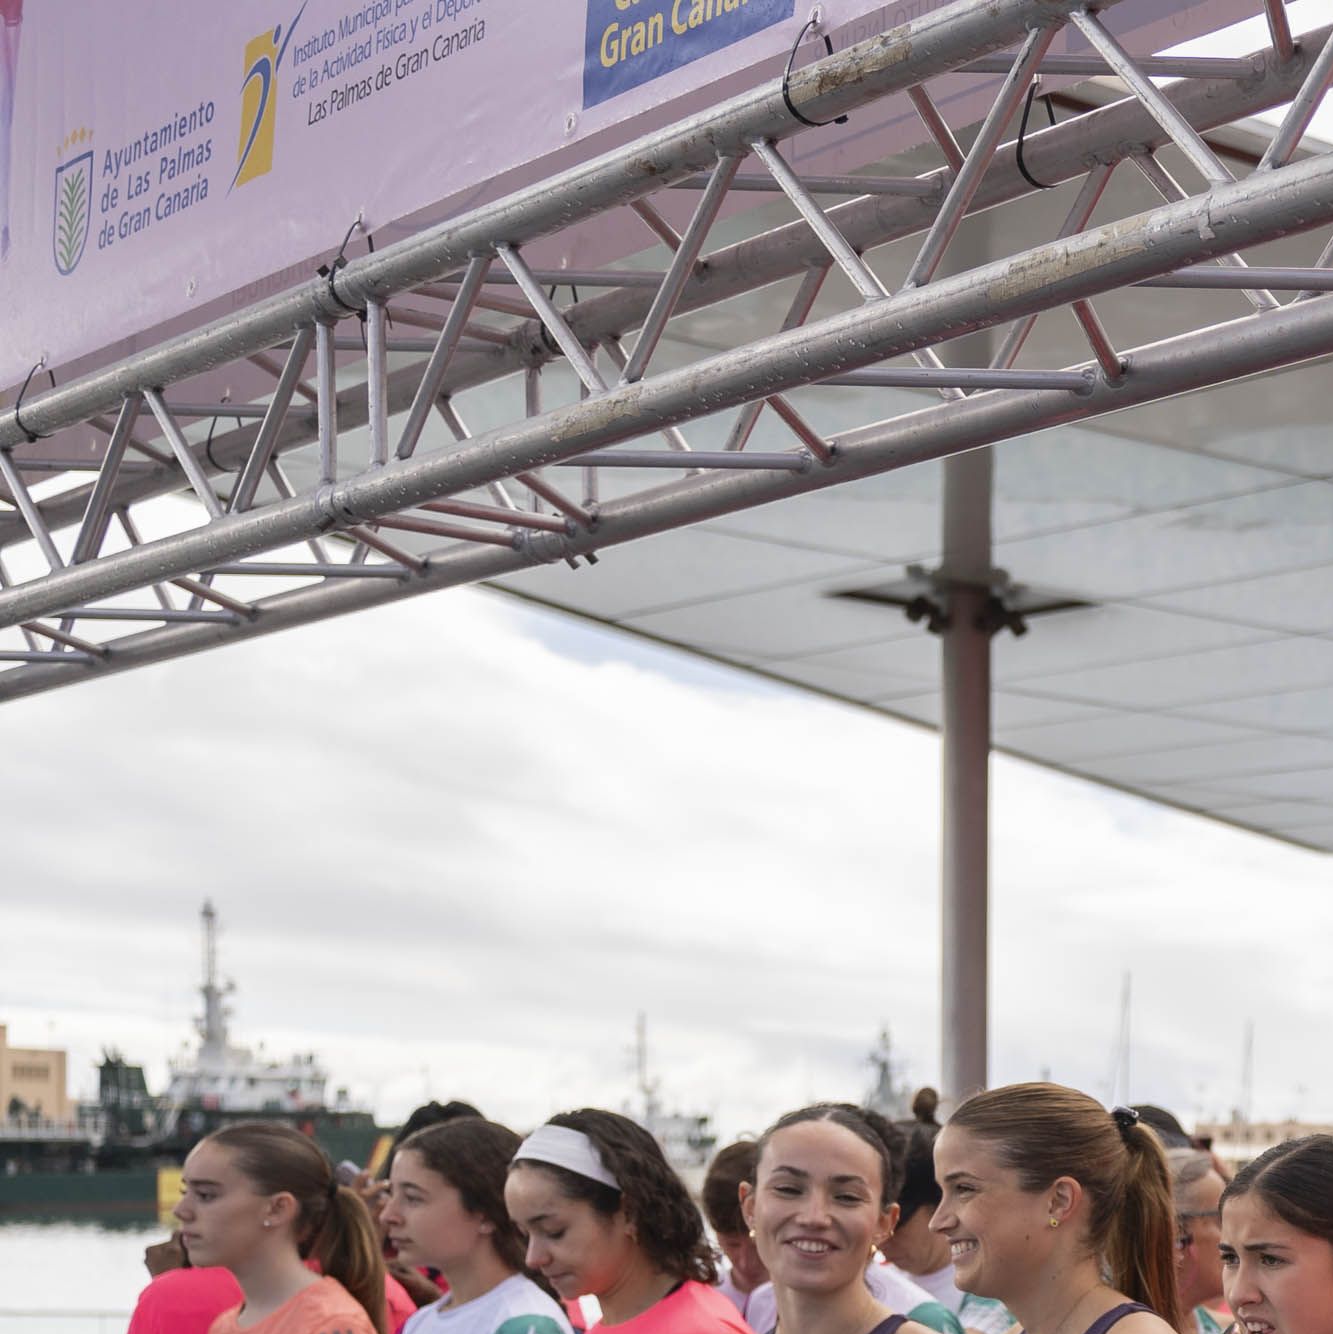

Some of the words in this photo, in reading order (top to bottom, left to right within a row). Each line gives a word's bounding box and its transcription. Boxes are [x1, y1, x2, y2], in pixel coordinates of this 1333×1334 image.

[292, 75, 306, 98] de
[309, 69, 318, 90] la
[321, 35, 372, 83] Actividad
[375, 22, 407, 54] Física
[408, 16, 418, 44] y
[422, 7, 432, 30] el
[293, 29, 336, 67] Instituto
[338, 0, 392, 42] Municipal
[307, 98, 327, 126] Las
[330, 75, 373, 115] Palmas
[375, 64, 392, 91] de
[395, 48, 428, 80] Gran
[432, 17, 486, 62] Canaria
[600, 12, 663, 68] Gran
[101, 183, 119, 214] de
[127, 171, 151, 200] Las
[159, 139, 212, 184] Palmas
[102, 101, 214, 180] Ayuntamiento
[98, 219, 115, 250] de
[118, 207, 151, 239] Gran
[155, 174, 209, 221] Canaria
